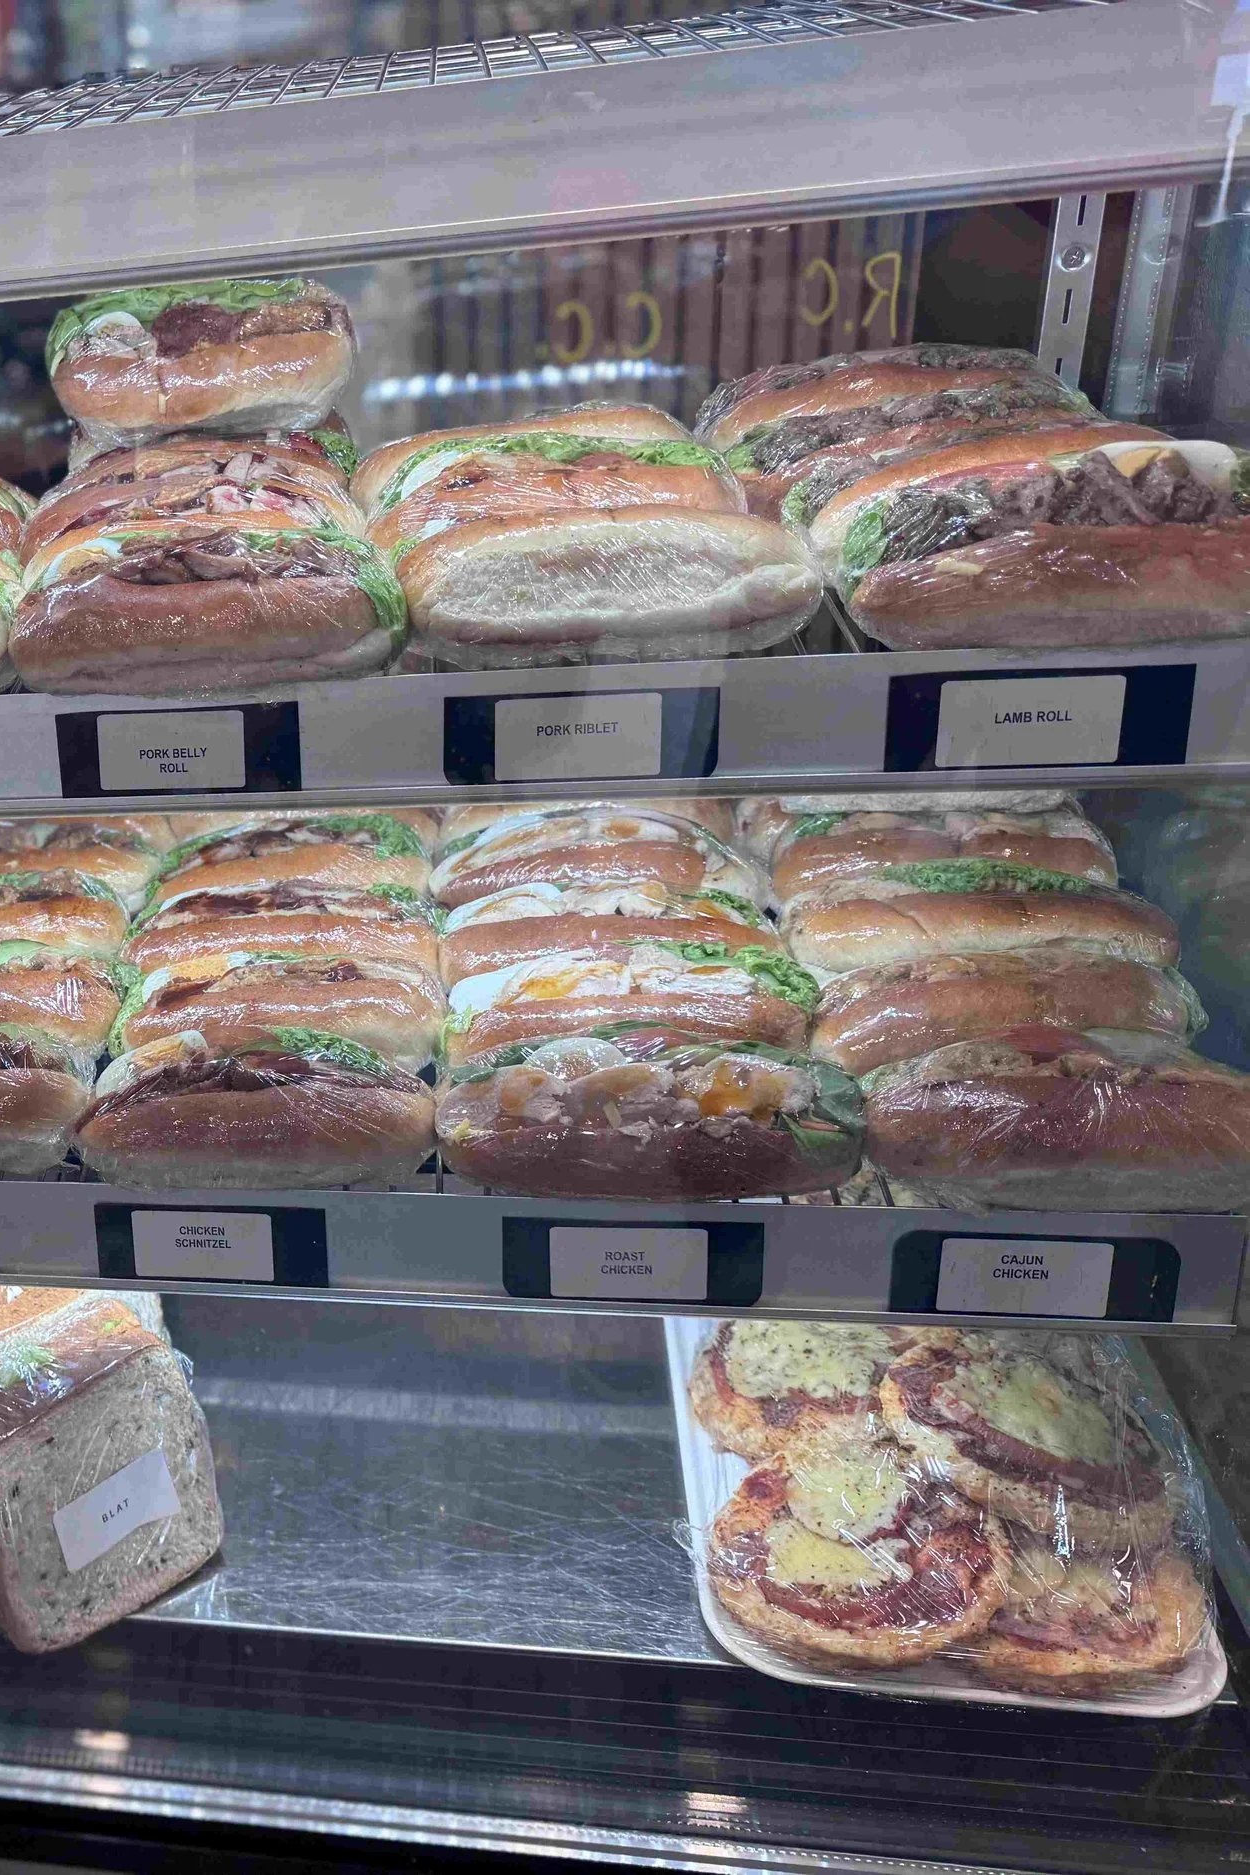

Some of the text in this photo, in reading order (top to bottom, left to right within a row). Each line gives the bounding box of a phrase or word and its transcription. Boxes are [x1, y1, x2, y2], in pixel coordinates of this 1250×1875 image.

[994, 710, 1073, 725] LAMB ROLL
[536, 722, 619, 737] PORK RIBLET
[139, 747, 208, 760] PORK BELLY
[159, 763, 188, 773] ROLL
[179, 1226, 225, 1236] CHICKEN
[175, 1238, 232, 1249] SCHNITZEL
[605, 1251, 646, 1261] ROAST
[1001, 1254, 1044, 1266] CAJUN
[600, 1265, 653, 1275] CHICKEN
[992, 1268, 1049, 1280] CHICKEN
[101, 1498, 129, 1523] BLAT
